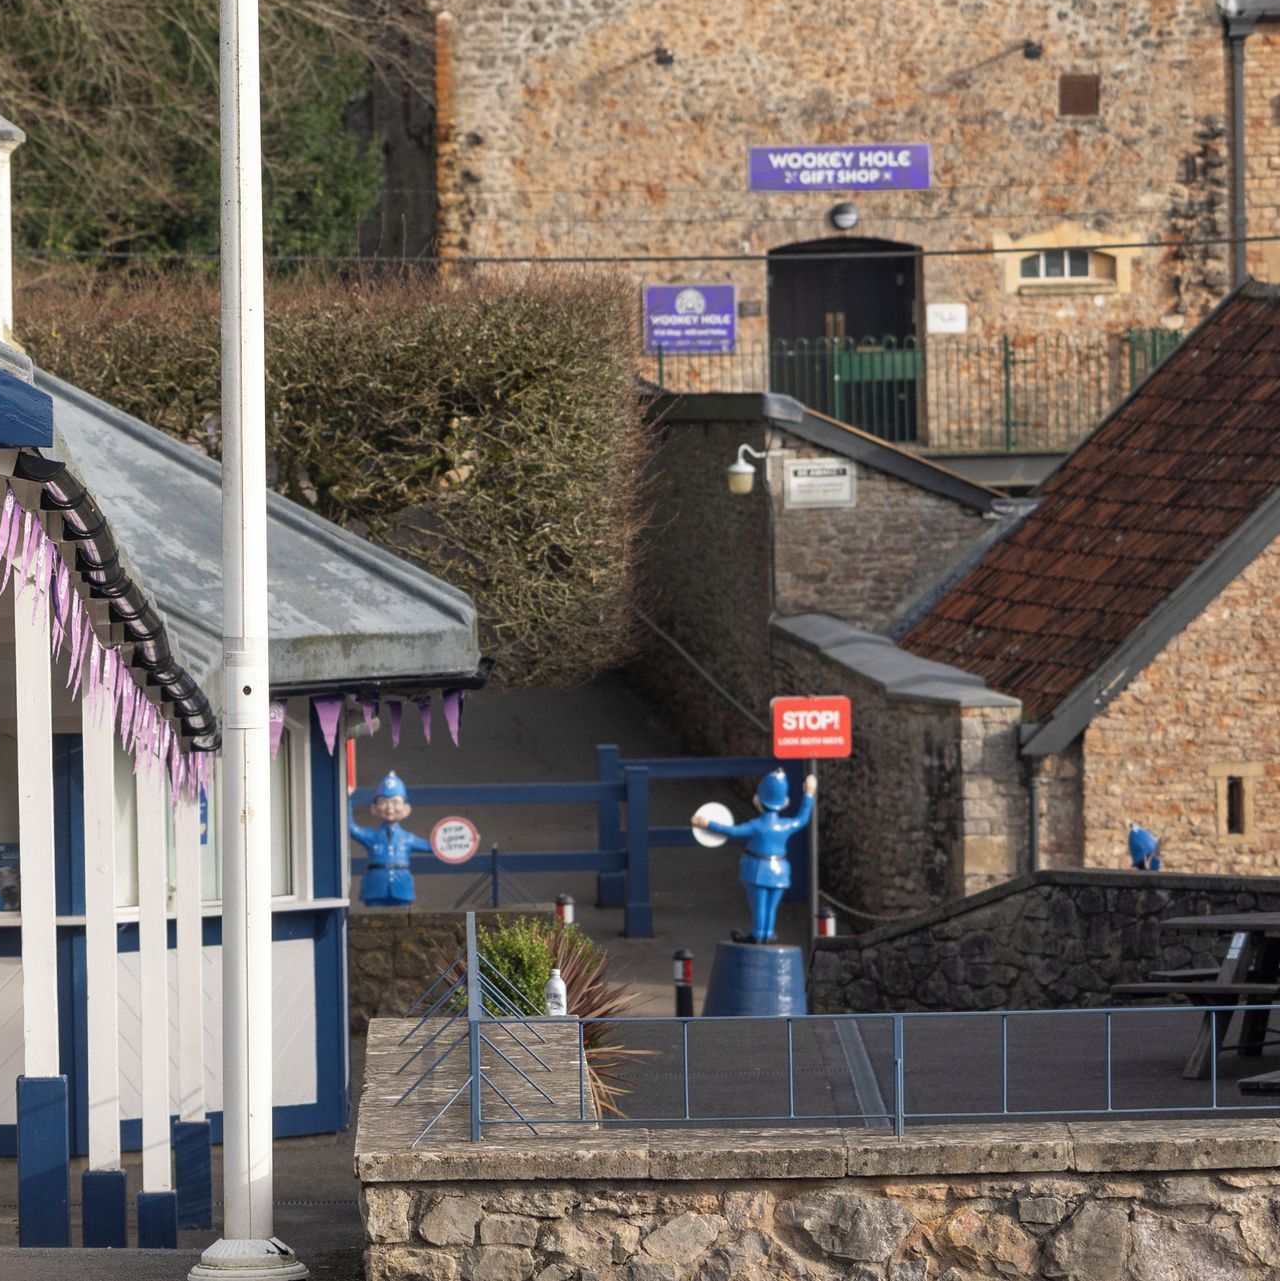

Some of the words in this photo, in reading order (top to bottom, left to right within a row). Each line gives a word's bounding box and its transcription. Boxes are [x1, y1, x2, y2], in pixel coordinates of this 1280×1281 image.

[768, 151, 853, 169] WOOKEY
[858, 150, 911, 168] HOLE
[799, 170, 835, 184] GIFT
[837, 169, 880, 184] SHOP
[650, 314, 699, 326] WOOKEY
[701, 313, 730, 326] HOLE
[782, 710, 840, 731] STOP!
